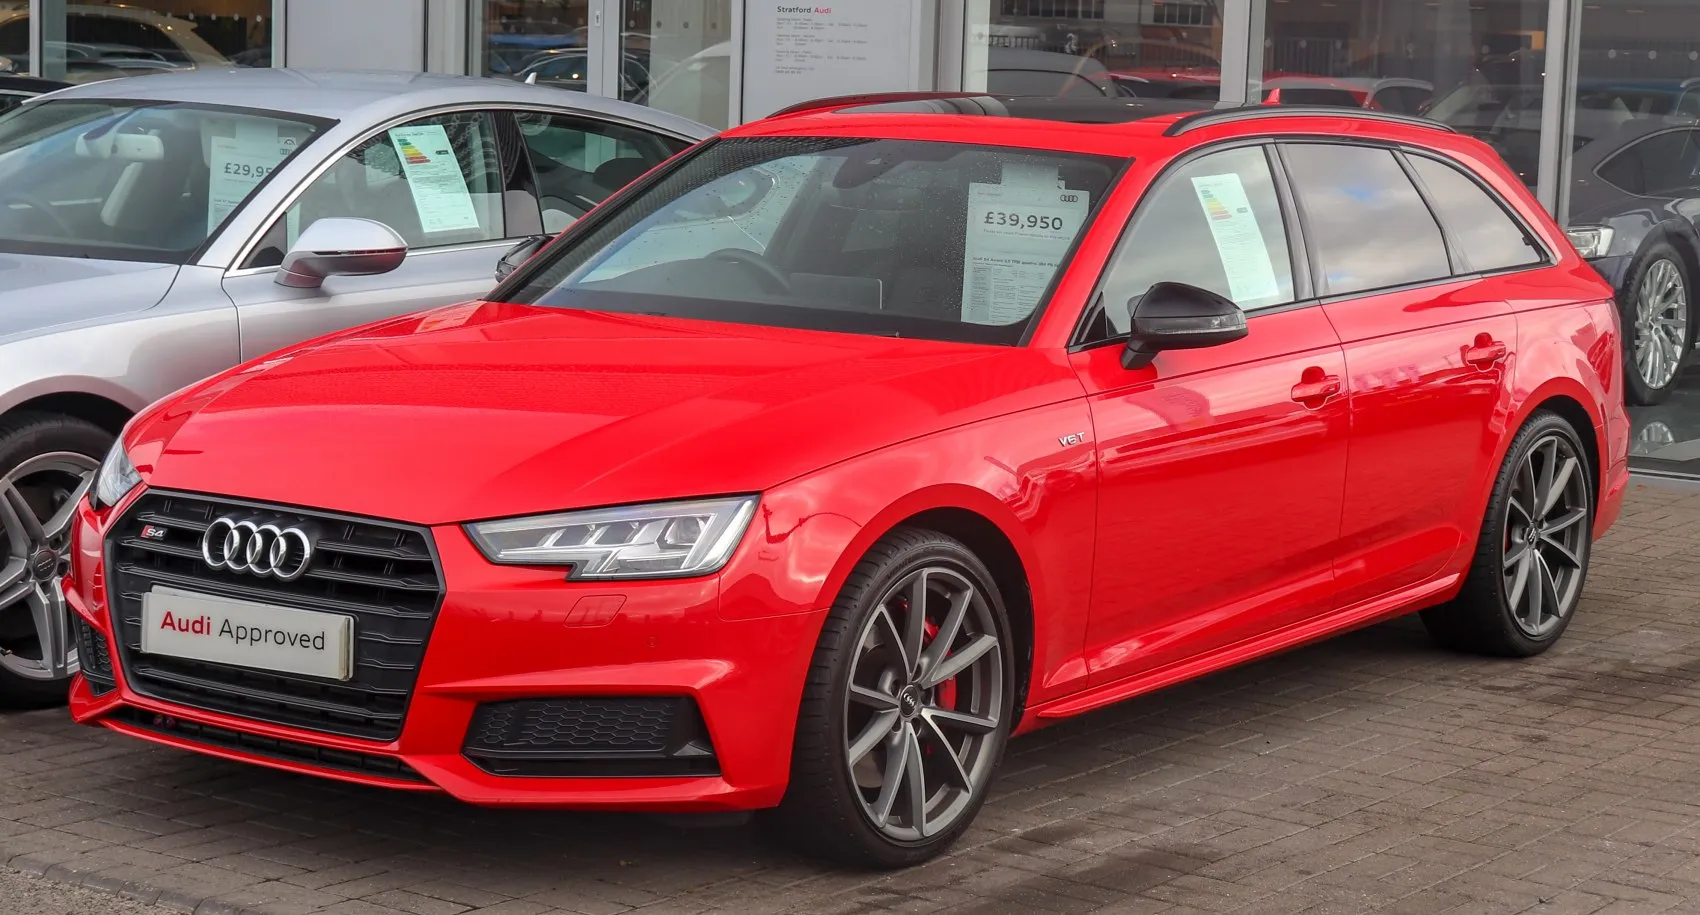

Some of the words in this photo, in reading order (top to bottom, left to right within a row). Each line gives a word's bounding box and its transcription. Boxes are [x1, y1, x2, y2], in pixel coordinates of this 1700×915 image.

[776, 6, 812, 14] Stratford
[983, 211, 1063, 231] £39,950
[1058, 431, 1085, 447] V6T
[145, 528, 164, 537] S4
[160, 611, 211, 636] Audi
[219, 618, 325, 650] Approved
